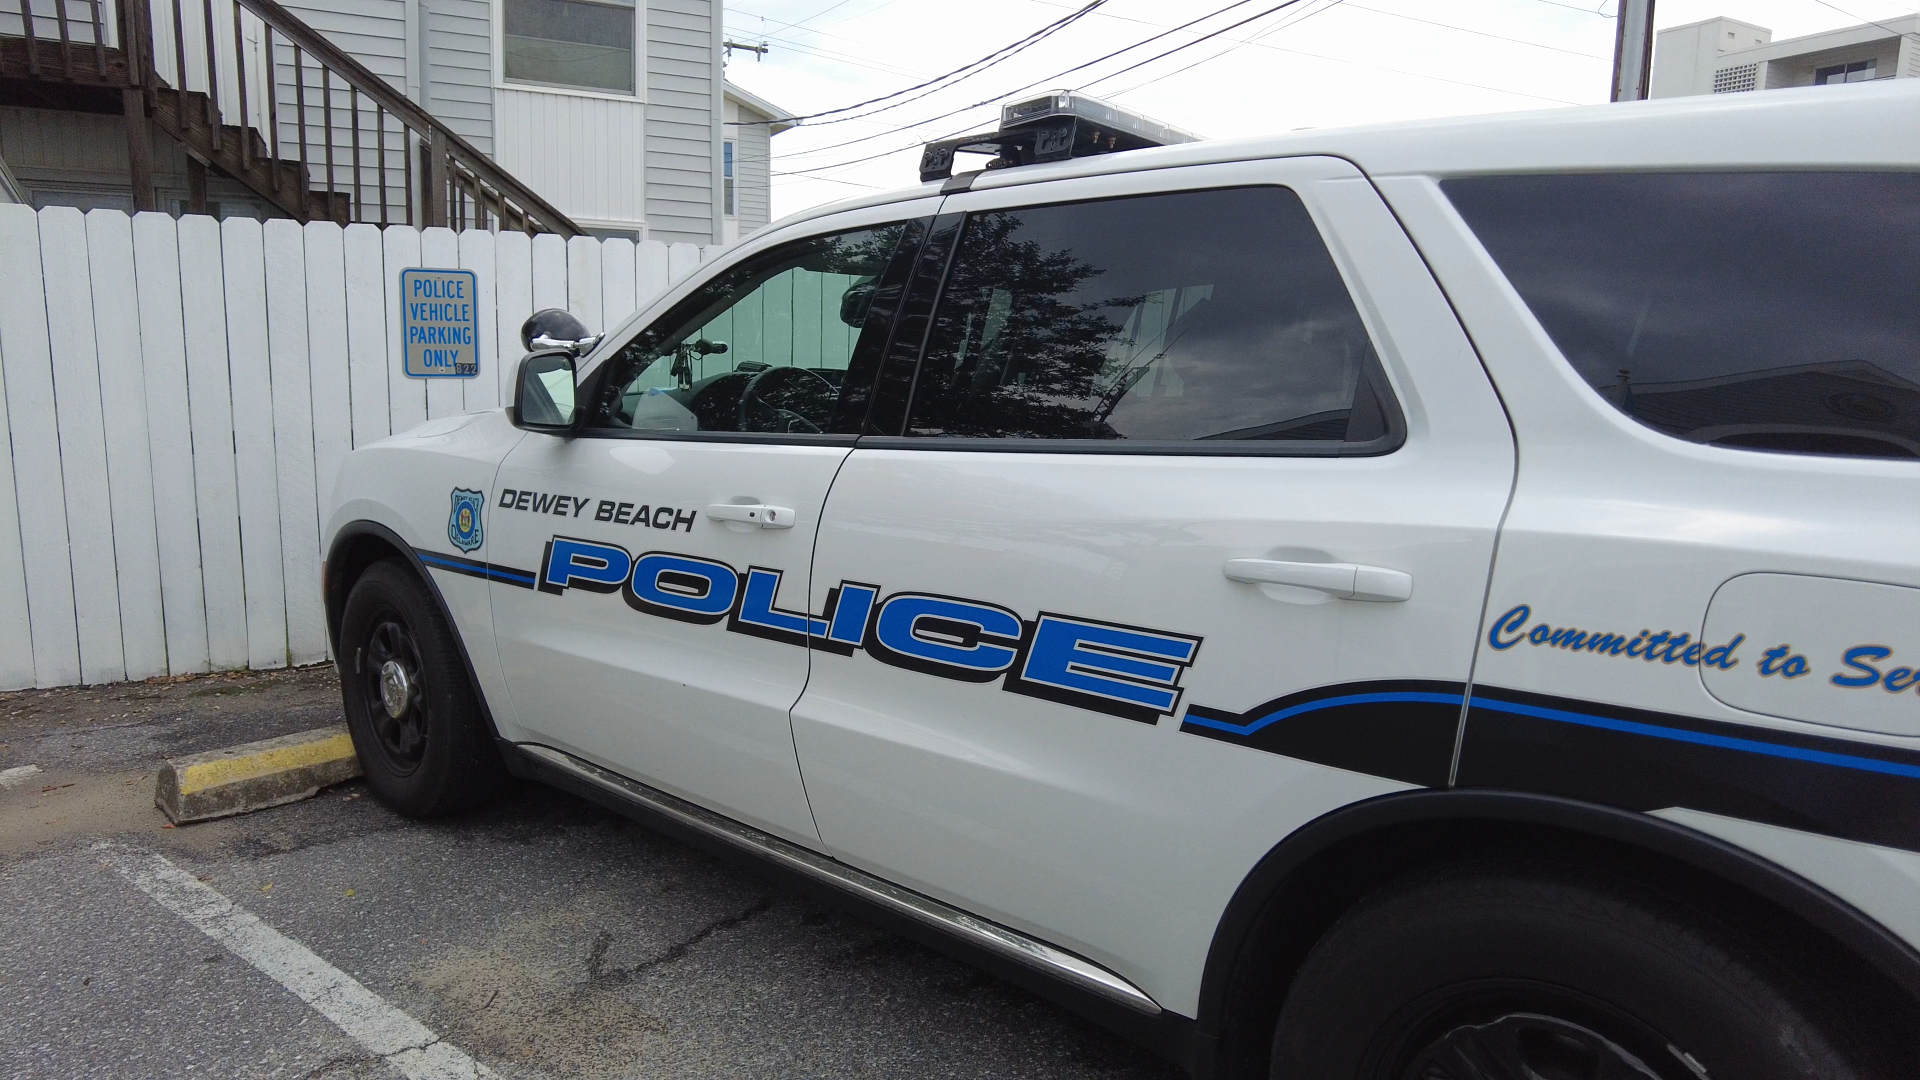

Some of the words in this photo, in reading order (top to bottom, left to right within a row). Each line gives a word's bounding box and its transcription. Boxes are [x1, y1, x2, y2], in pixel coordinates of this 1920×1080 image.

[413, 279, 465, 298] POLICE
[410, 302, 470, 322] VEHICLE
[410, 326, 471, 345] PARKING
[423, 349, 459, 367] ONLY
[499, 489, 590, 518] DEWEY
[594, 500, 697, 532] BEACH
[538, 534, 1204, 725] POLICE
[1488, 604, 1746, 669] Committed
[1757, 645, 1811, 677] to
